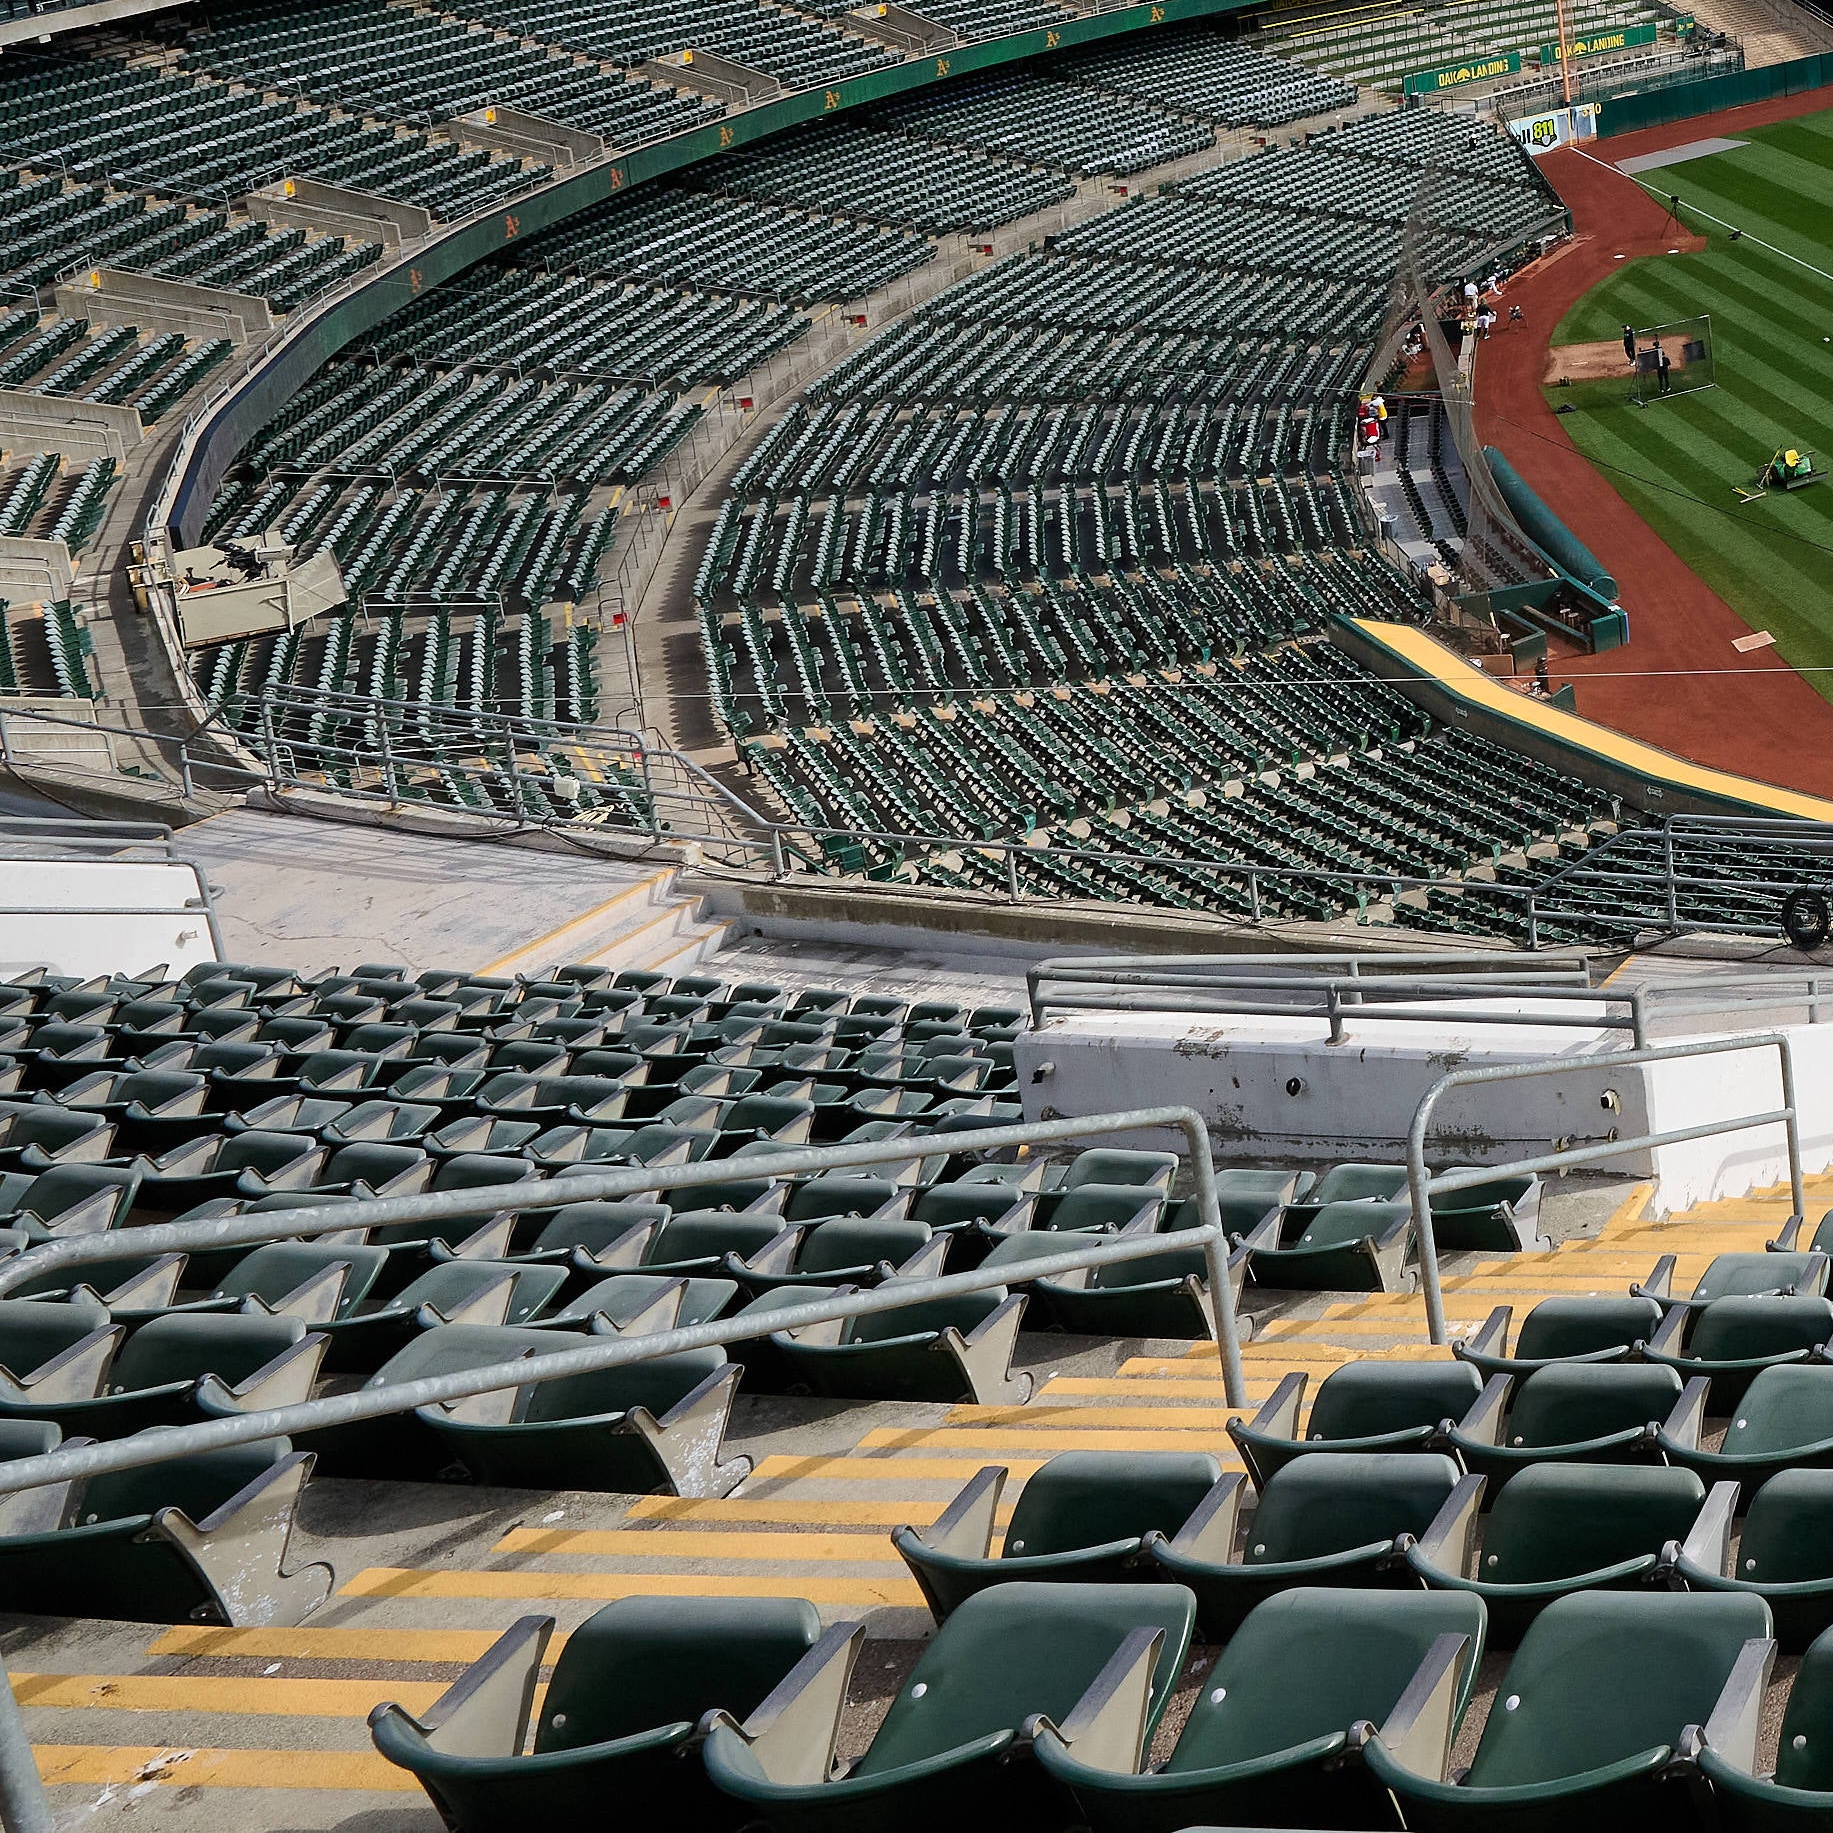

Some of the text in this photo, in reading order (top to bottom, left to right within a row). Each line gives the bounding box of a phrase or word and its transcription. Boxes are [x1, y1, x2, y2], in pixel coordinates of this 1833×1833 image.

[1587, 34, 1625, 54] LANDING
[1439, 58, 1509, 87] OAK LANDING
[1533, 120, 1554, 139] 811
